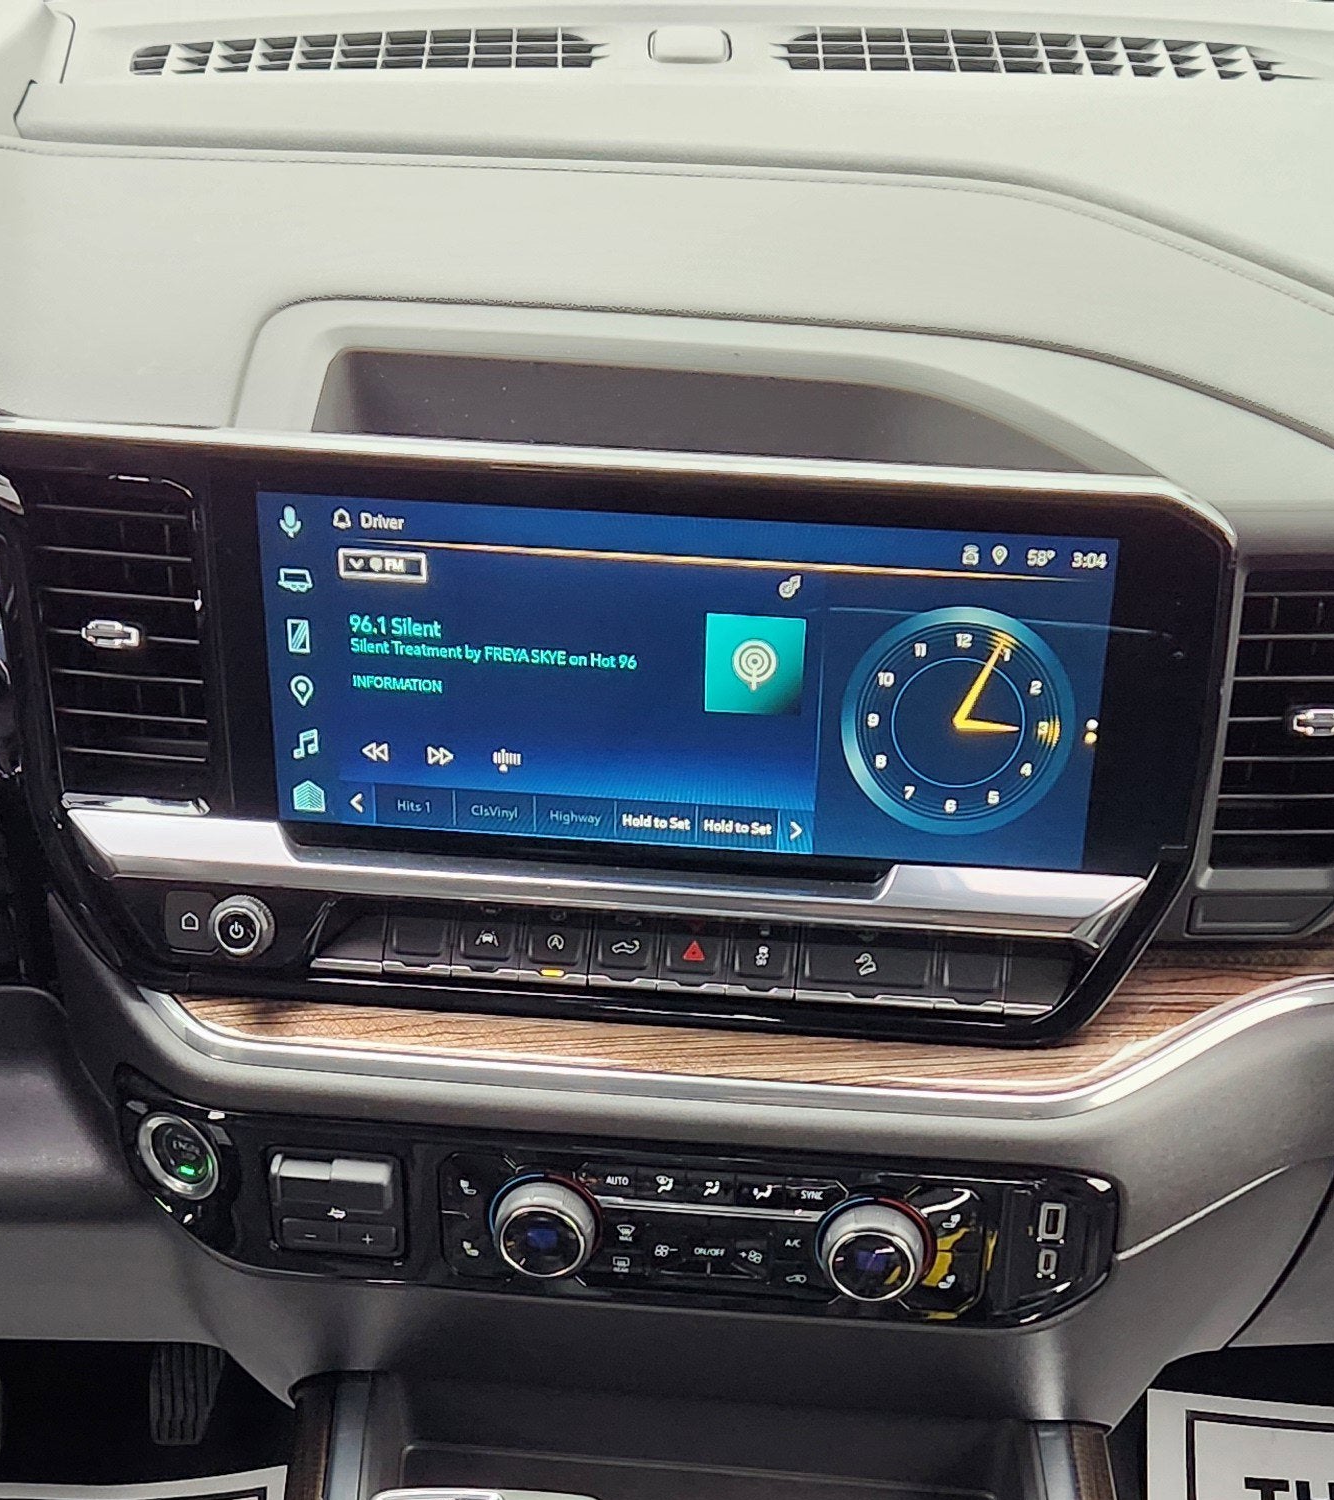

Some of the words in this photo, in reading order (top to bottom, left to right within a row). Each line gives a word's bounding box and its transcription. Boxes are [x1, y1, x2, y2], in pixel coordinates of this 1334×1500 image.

[360, 511, 405, 531] Driver
[384, 558, 406, 573] FM
[1071, 552, 1108, 569] 3:04
[349, 613, 386, 635] 96.1
[390, 616, 442, 639] Silent
[955, 633, 973, 648] 12
[350, 637, 390, 654] Silent
[391, 639, 463, 659] Treatment
[464, 644, 482, 663] by
[484, 646, 530, 663] FREYA
[530, 649, 567, 666] SKYE
[568, 655, 588, 667] on
[590, 652, 617, 669] Hot
[618, 654, 638, 671] 96
[914, 642, 927, 658] 11
[352, 674, 443, 694] INFORMATION
[877, 671, 895, 688] 10
[1028, 680, 1042, 695] 2
[867, 712, 880, 728] 9
[875, 754, 887, 769] 8
[1019, 762, 1033, 778] 4
[903, 785, 916, 800] 7
[987, 790, 1000, 806] 5
[397, 799, 423, 813] Hits
[944, 798, 957, 814] 6
[549, 809, 602, 827] Highway
[622, 813, 652, 828] Hold
[653, 816, 667, 829] to
[669, 817, 691, 831] Set
[703, 819, 733, 833] Hold
[734, 821, 749, 834] to
[750, 821, 772, 837] Set
[605, 1175, 629, 1187] AUTO
[800, 1189, 824, 1201] SYNC
[785, 1238, 802, 1249] A/C
[693, 1246, 726, 1258] ON/OFF
